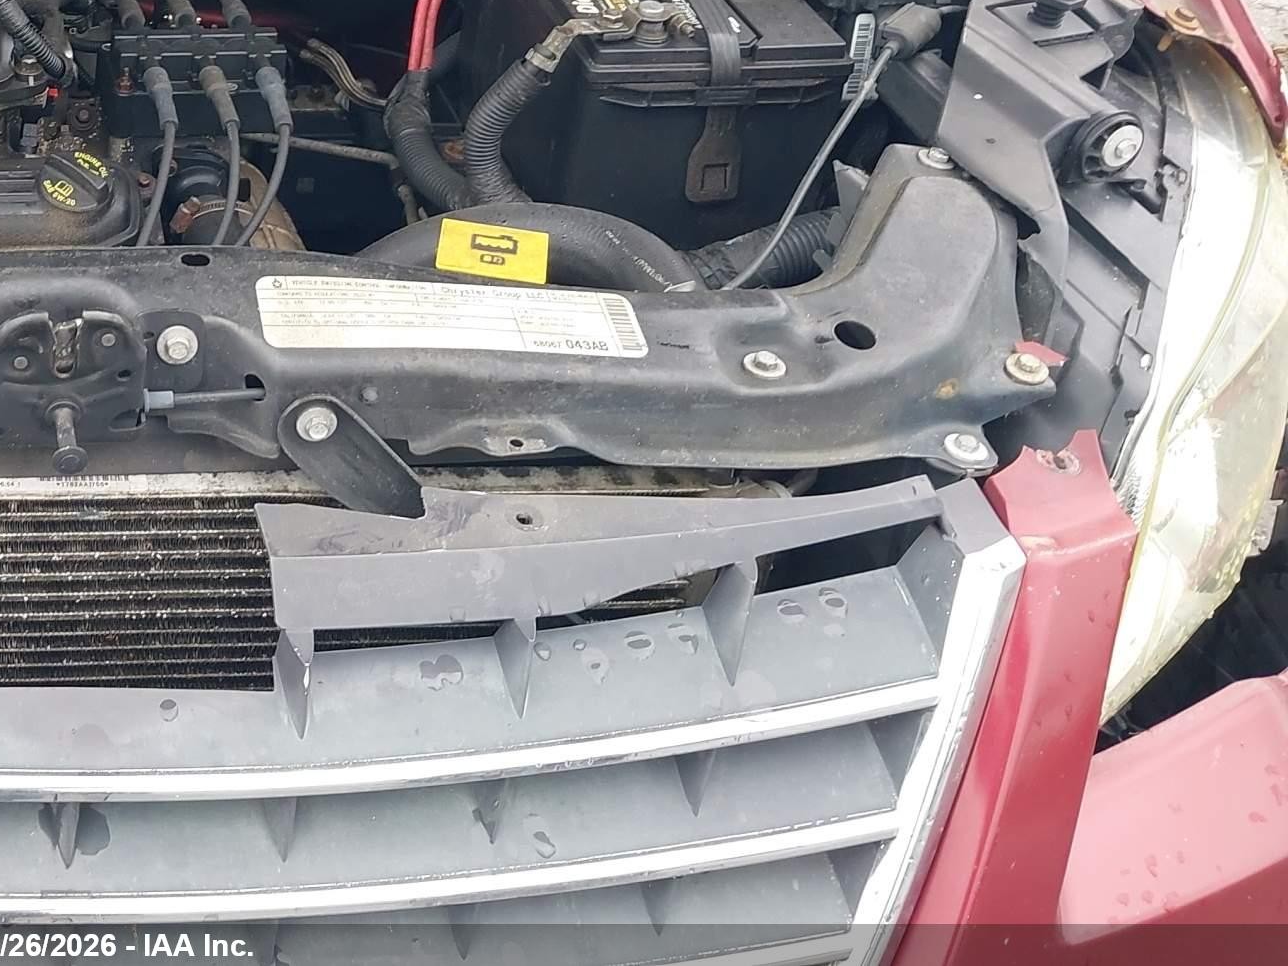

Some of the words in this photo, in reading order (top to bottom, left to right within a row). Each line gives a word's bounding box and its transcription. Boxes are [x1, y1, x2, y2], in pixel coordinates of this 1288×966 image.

[440, 286, 486, 297] Chrysler
[492, 289, 522, 300] Group
[526, 290, 546, 299] LLC
[565, 339, 609, 351] 043AB
